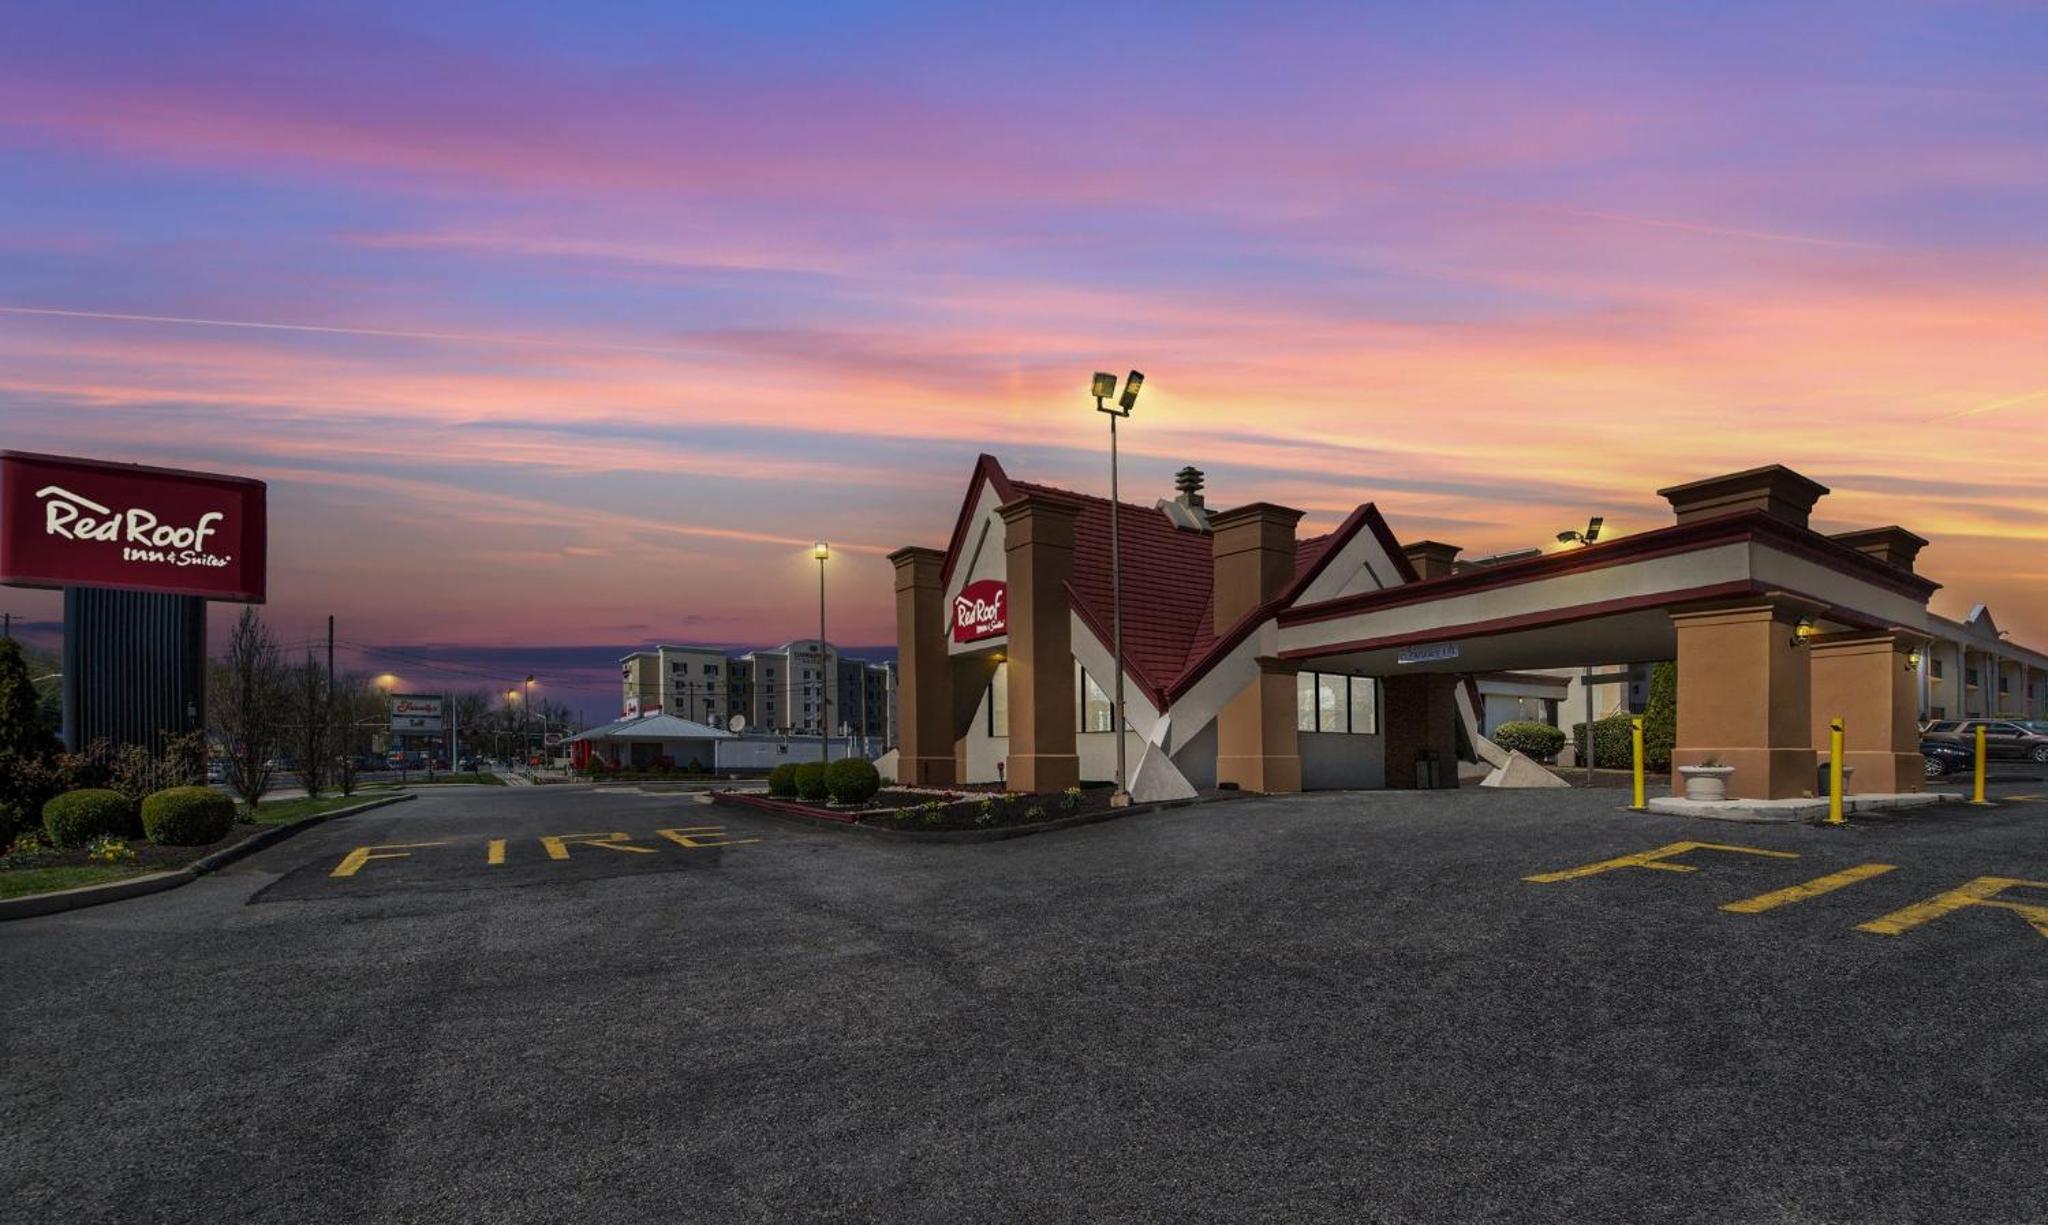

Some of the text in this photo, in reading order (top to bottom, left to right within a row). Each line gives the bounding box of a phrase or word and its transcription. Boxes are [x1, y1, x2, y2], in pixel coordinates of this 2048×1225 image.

[47, 501, 224, 551] Red Roof
[124, 547, 164, 562] Inn
[176, 550, 228, 567] Suites
[957, 604, 977, 627] Red
[976, 590, 1003, 622] Roof
[329, 826, 762, 877] FIRE
